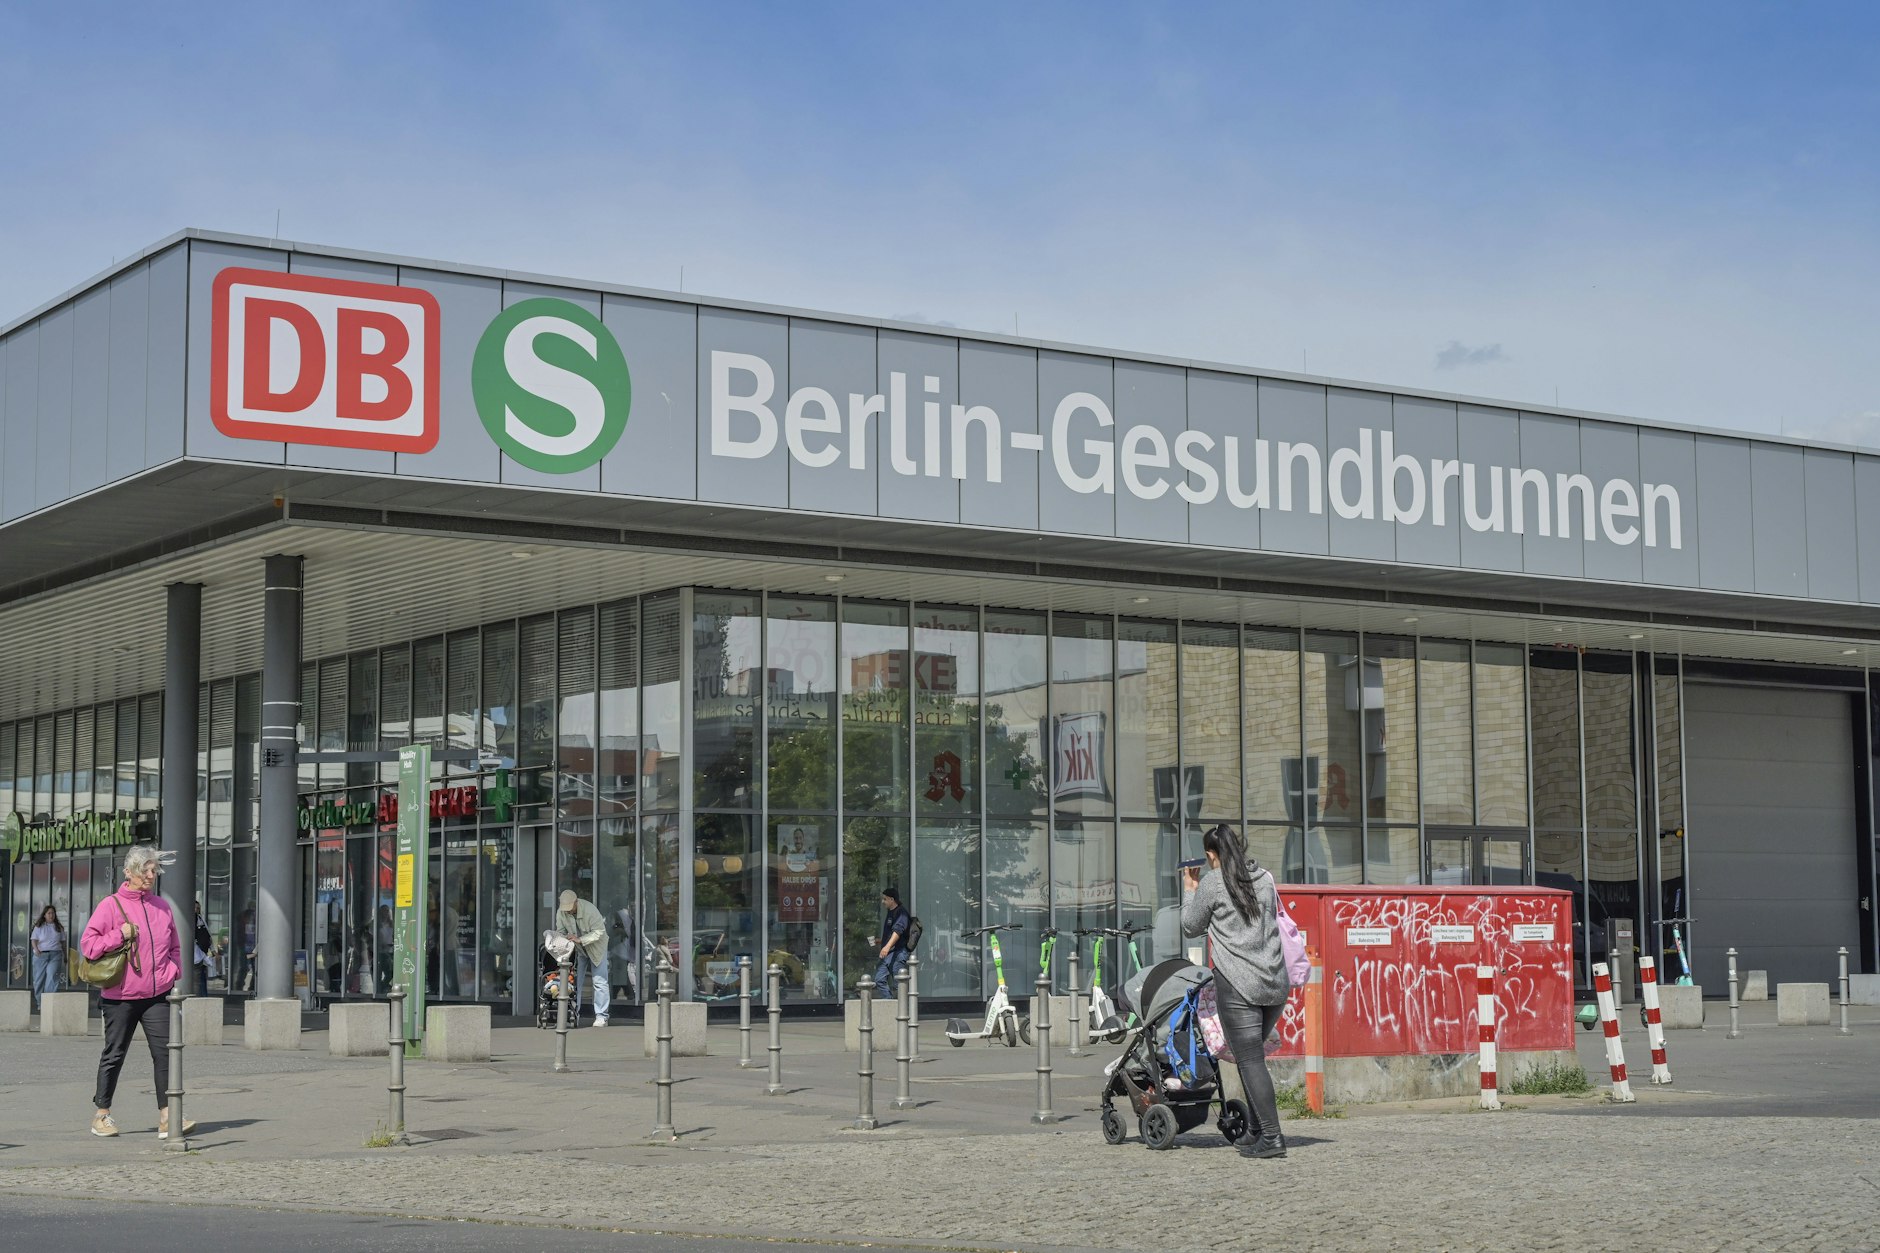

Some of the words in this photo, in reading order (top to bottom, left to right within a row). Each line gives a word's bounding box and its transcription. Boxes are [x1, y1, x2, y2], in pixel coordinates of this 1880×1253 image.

[242, 296, 413, 422] DB
[504, 316, 605, 455] S
[711, 350, 1682, 550] Berlin-Gesundbrunnen
[866, 703, 950, 726] faracia
[403, 760, 413, 769] Hub
[297, 799, 372, 831] ordkreuz
[378, 786, 477, 822] APHEKE
